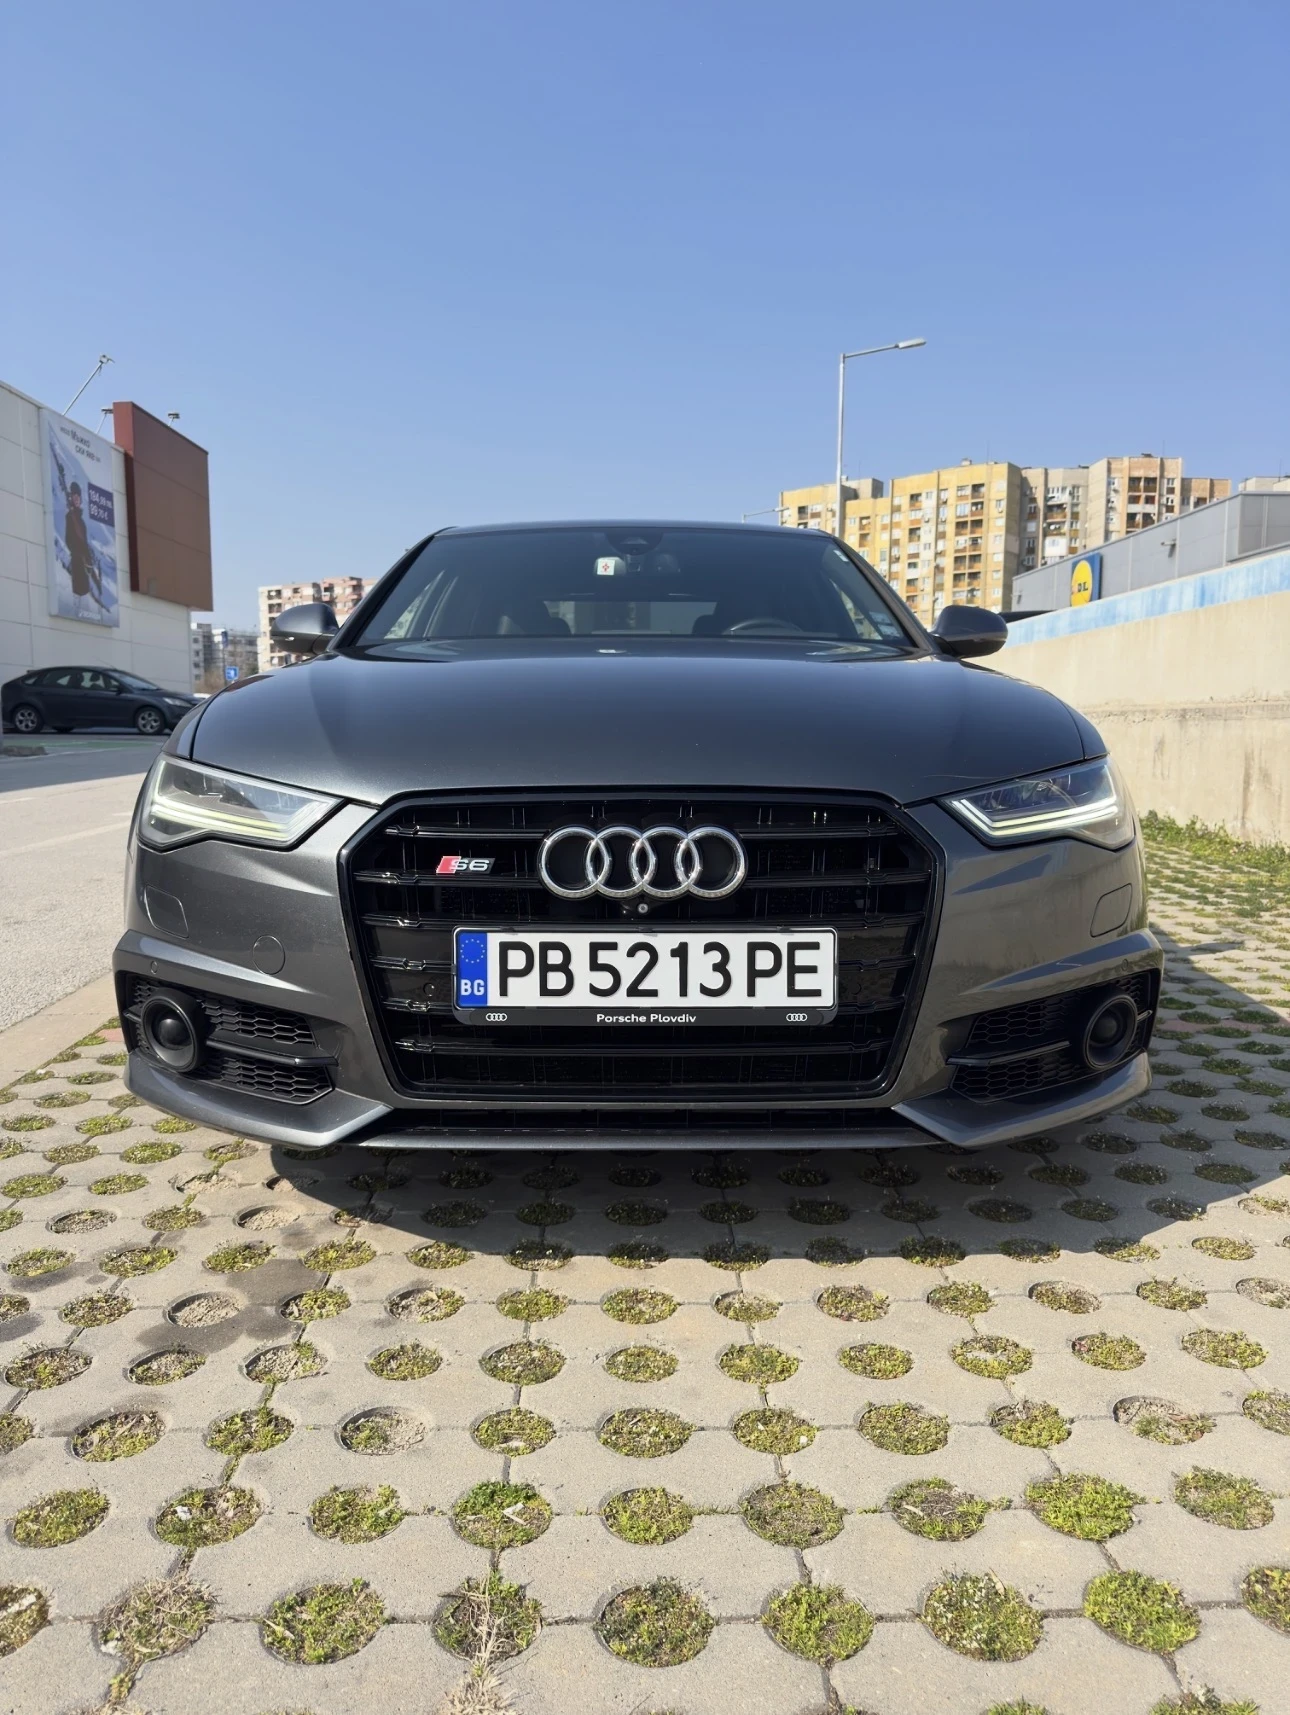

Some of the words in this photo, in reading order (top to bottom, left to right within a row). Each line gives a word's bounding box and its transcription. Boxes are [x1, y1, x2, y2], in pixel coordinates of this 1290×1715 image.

[449, 859, 490, 871] S6
[498, 941, 574, 997] PB
[588, 941, 731, 998] 5213
[746, 941, 821, 997] PE
[461, 979, 485, 996] BG
[596, 1013, 647, 1023] Porsche
[650, 1013, 697, 1023] Plovdiv
